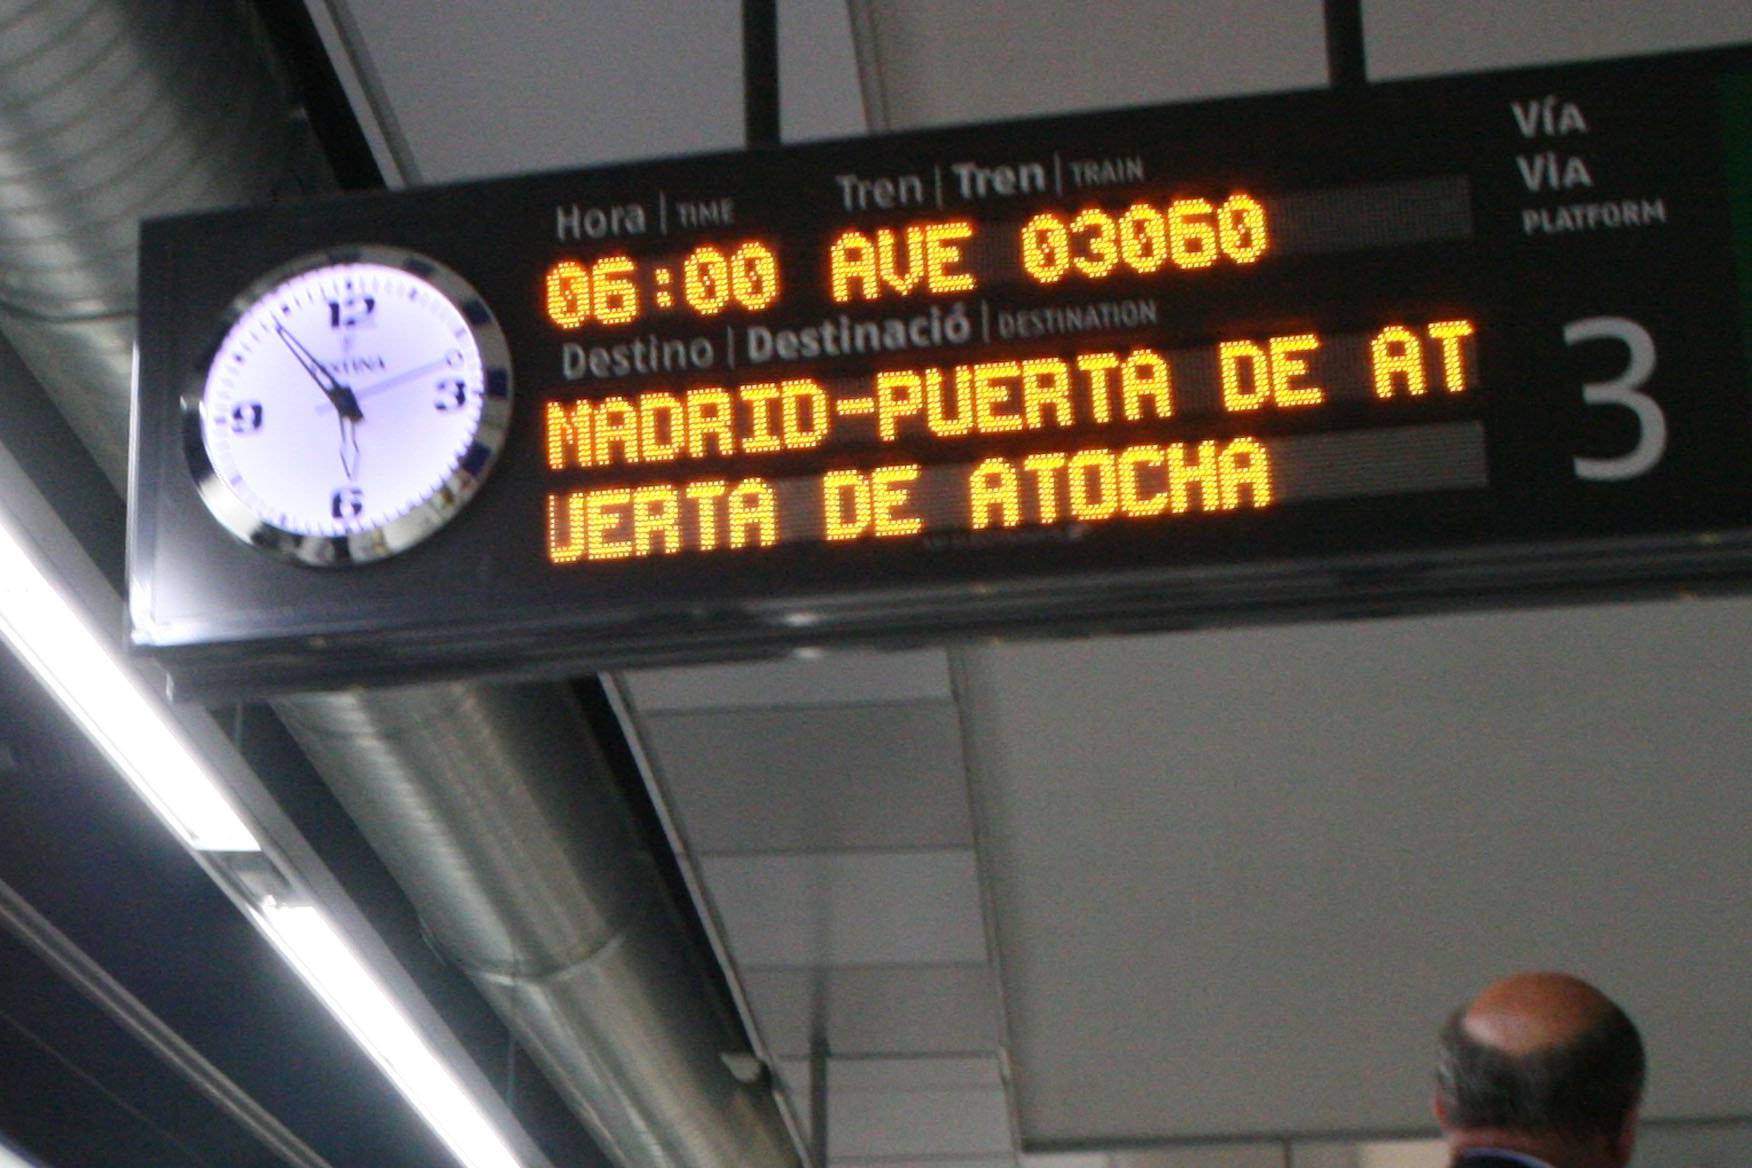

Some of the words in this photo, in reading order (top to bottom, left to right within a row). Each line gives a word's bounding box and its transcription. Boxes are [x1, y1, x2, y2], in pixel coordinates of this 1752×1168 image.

[836, 172, 923, 212] Tren
[951, 160, 1046, 199] Tren
[1069, 154, 1145, 186] TRAIN
[556, 203, 646, 242] Hora
[675, 199, 735, 228] TIME
[1522, 199, 1667, 235] PLATFORM
[546, 240, 779, 330] 06:00
[829, 220, 978, 302] AVE
[1021, 193, 1270, 284] 03060
[328, 294, 376, 329] 12
[561, 334, 715, 382] Destino
[748, 302, 972, 364] Destinació
[998, 298, 1158, 340] DESTINATION
[231, 400, 264, 434] 9
[433, 377, 467, 412] 3
[546, 348, 1175, 470] MADRID-PUERTA
[1218, 333, 1325, 412] DE
[1370, 319, 1475, 399] AT
[1561, 315, 1670, 482] 3
[330, 486, 366, 521] 6
[823, 463, 924, 541] DE
[968, 436, 1273, 530] ATOCHA
